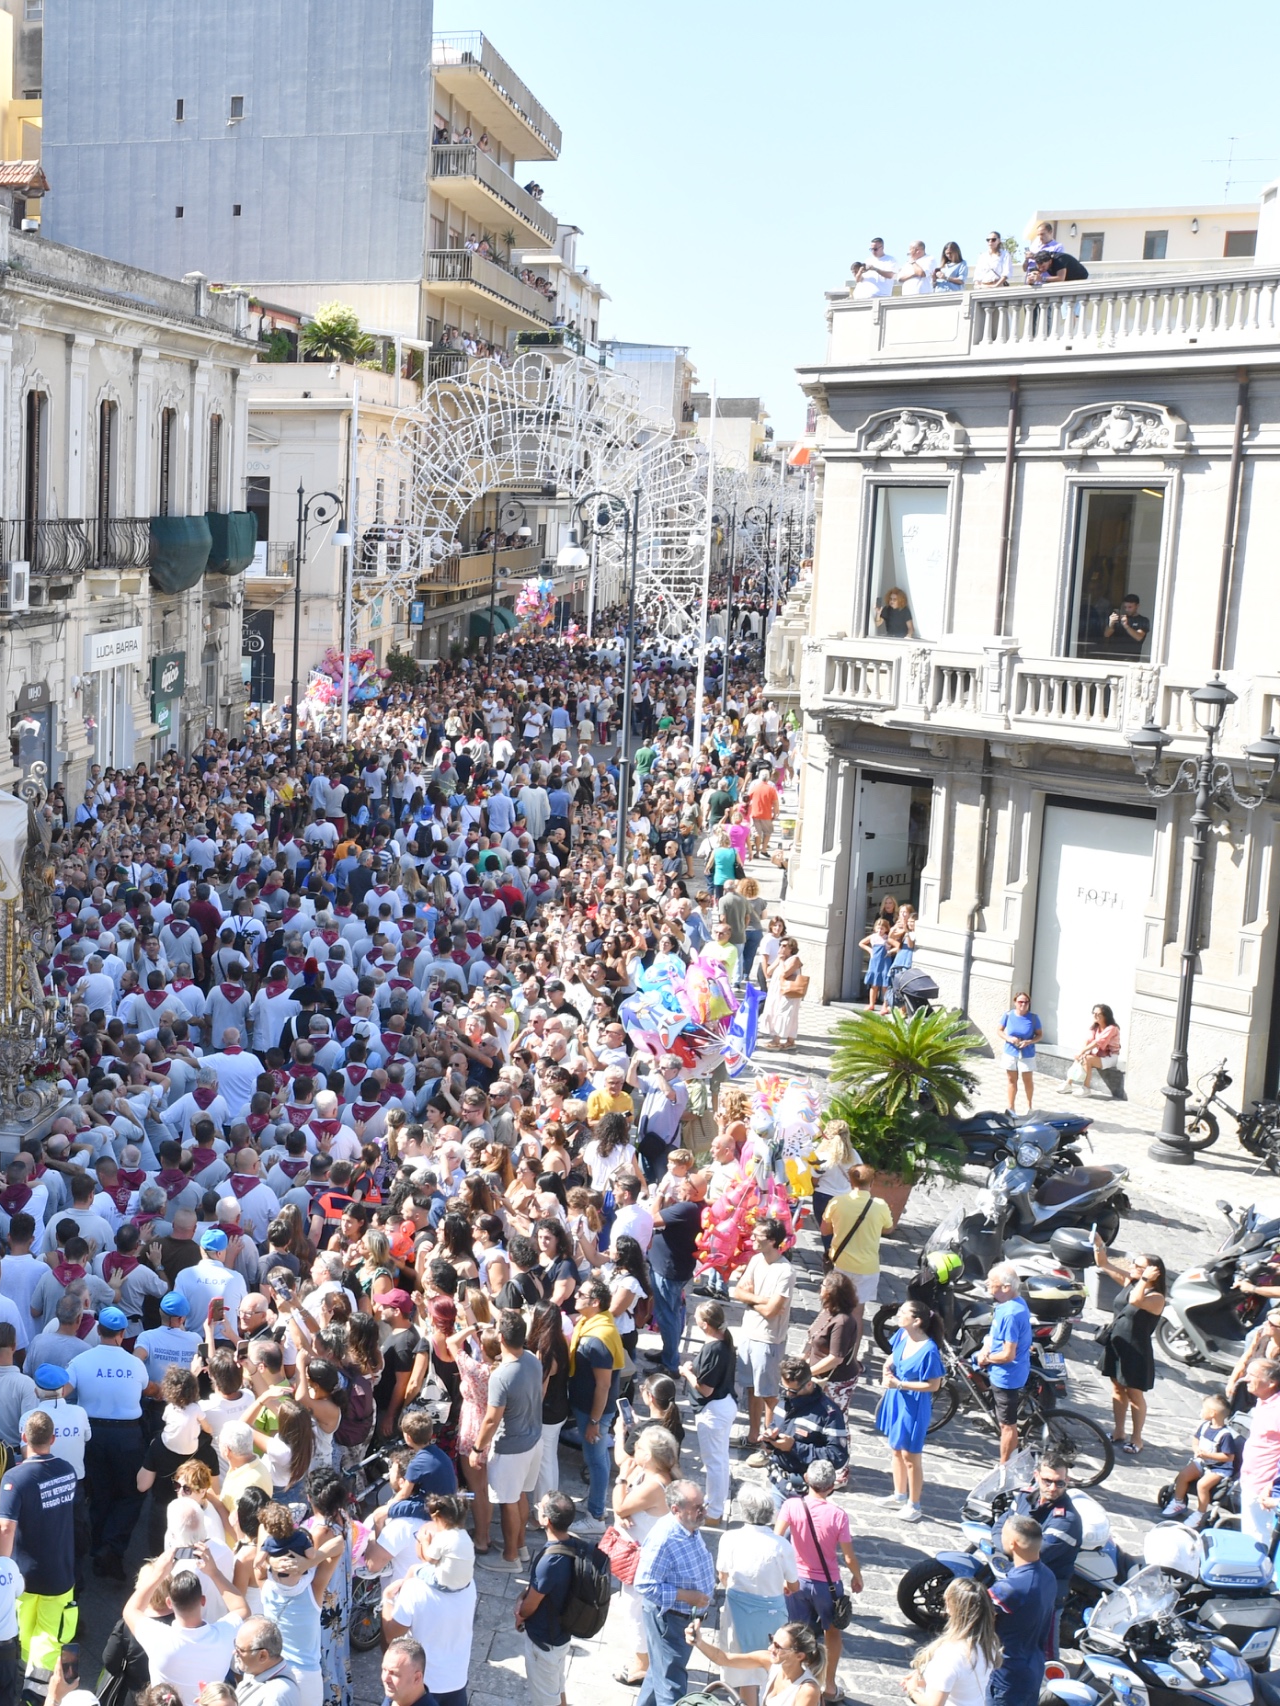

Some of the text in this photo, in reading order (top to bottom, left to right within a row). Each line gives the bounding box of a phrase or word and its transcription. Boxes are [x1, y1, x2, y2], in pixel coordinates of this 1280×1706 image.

[96, 639, 139, 659] LUCA BARRA
[879, 873, 907, 885] FOTI
[1077, 886, 1118, 903] FOTI
[196, 1277, 227, 1286] A.E.O.P.
[96, 1368, 134, 1379] A.E.O.P.
[42, 1497, 61, 1509] REGGIO
[1212, 1576, 1260, 1584] POLIZIA
